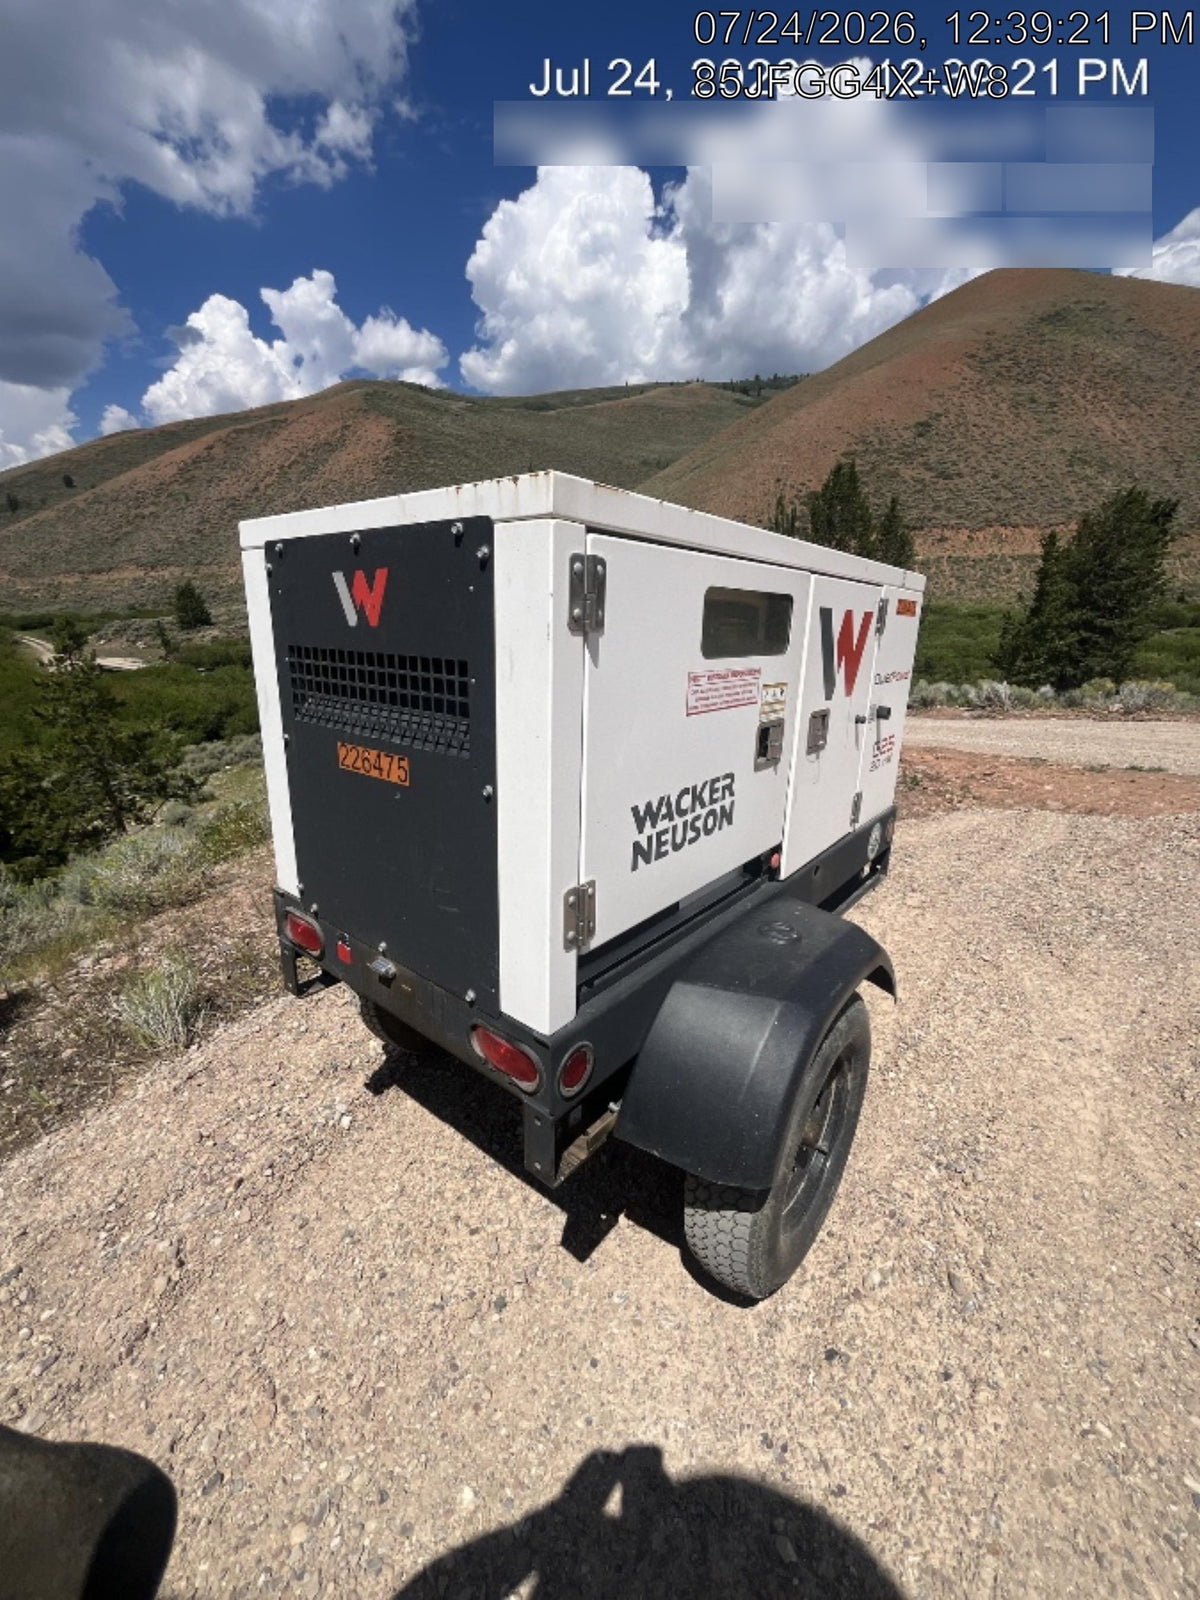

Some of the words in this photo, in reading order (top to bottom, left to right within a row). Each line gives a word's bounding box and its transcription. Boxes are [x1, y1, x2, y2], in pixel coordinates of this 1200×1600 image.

[340, 744, 409, 783] 226475
[631, 772, 735, 835] WACKER
[631, 800, 735, 872] NEUSON
